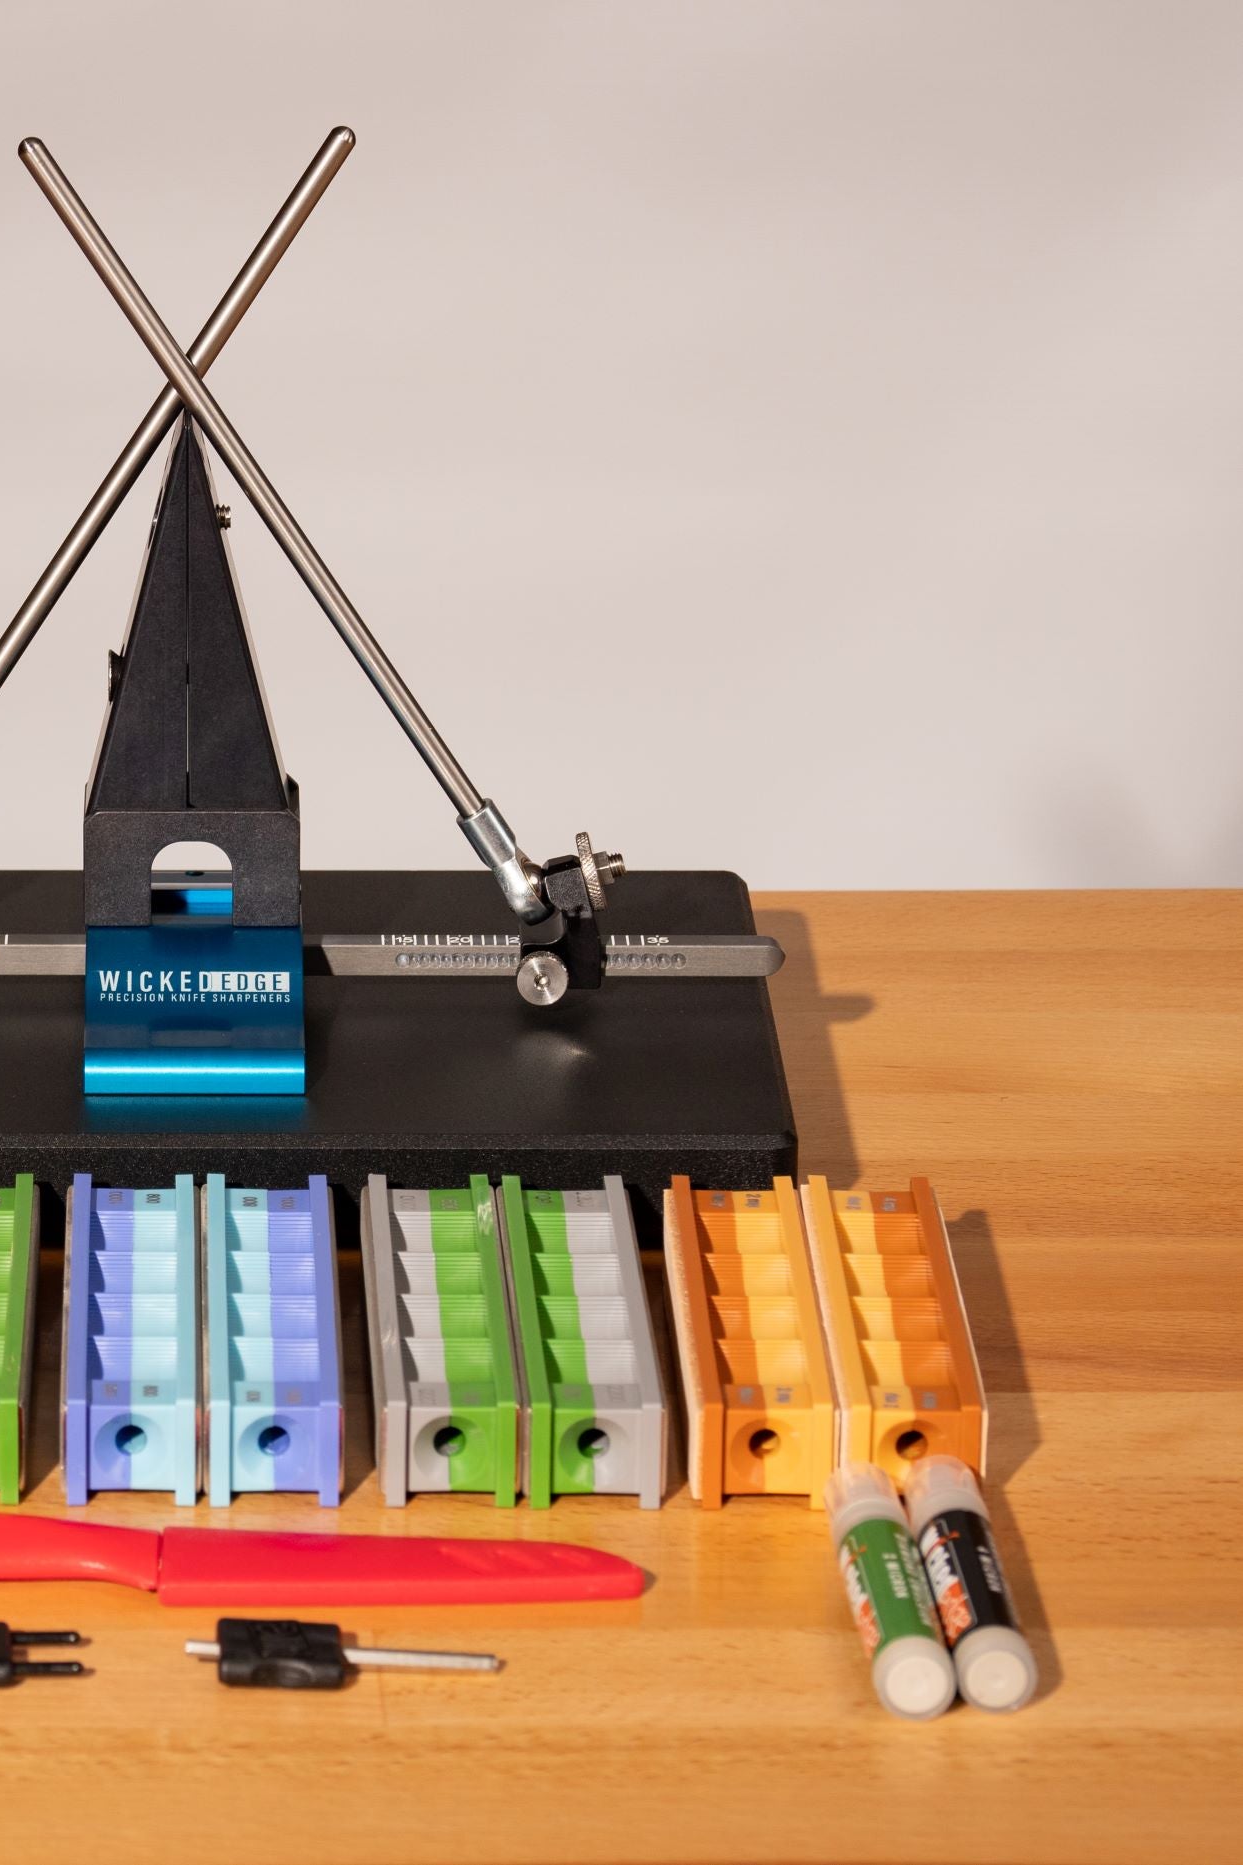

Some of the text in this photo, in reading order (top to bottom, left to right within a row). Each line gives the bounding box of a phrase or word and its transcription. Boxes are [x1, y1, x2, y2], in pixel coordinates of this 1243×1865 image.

[646, 936, 670, 944] 35
[98, 970, 283, 992] WICKED EDGE
[100, 993, 291, 1003] PRECISION KNIFE SHARPENERS
